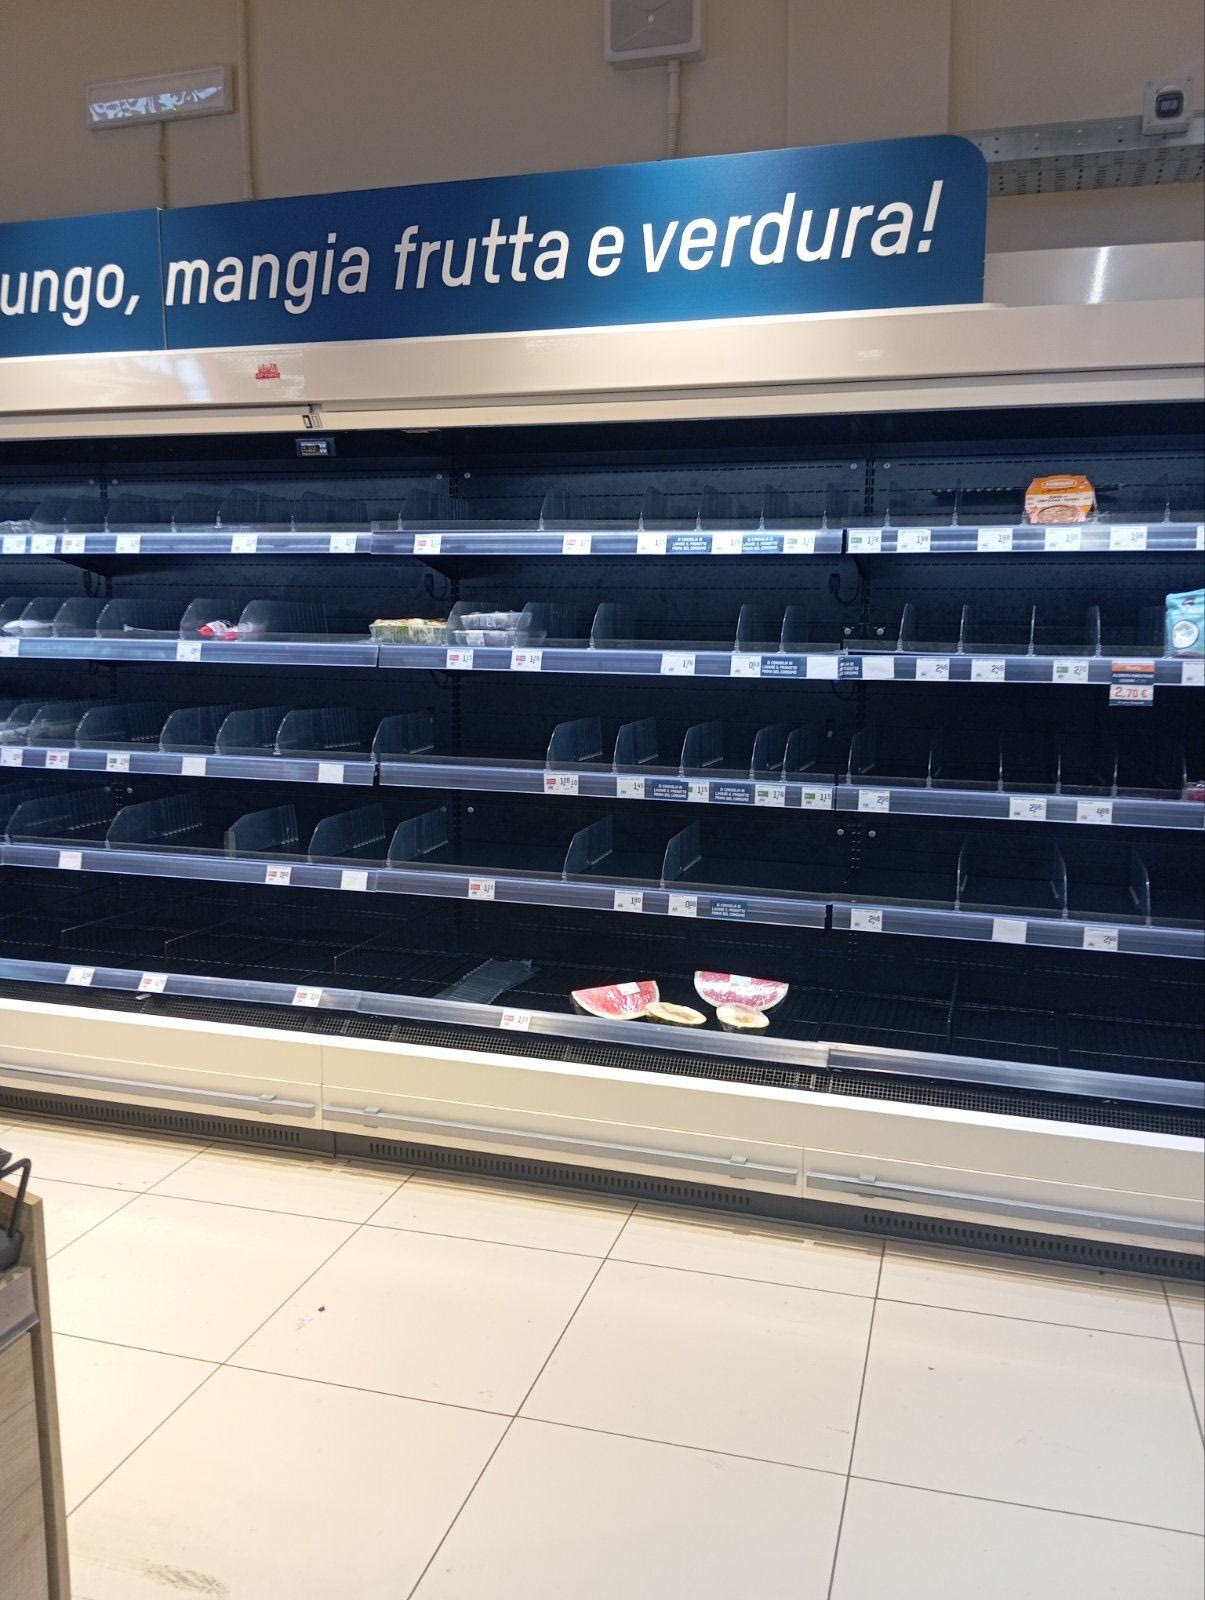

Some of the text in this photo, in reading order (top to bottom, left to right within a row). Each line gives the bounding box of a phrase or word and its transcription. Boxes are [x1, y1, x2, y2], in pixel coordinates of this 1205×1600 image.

[0, 179, 944, 327] ungo, mangia frutta e verdura!
[1115, 686, 1148, 698] 2,70 €
